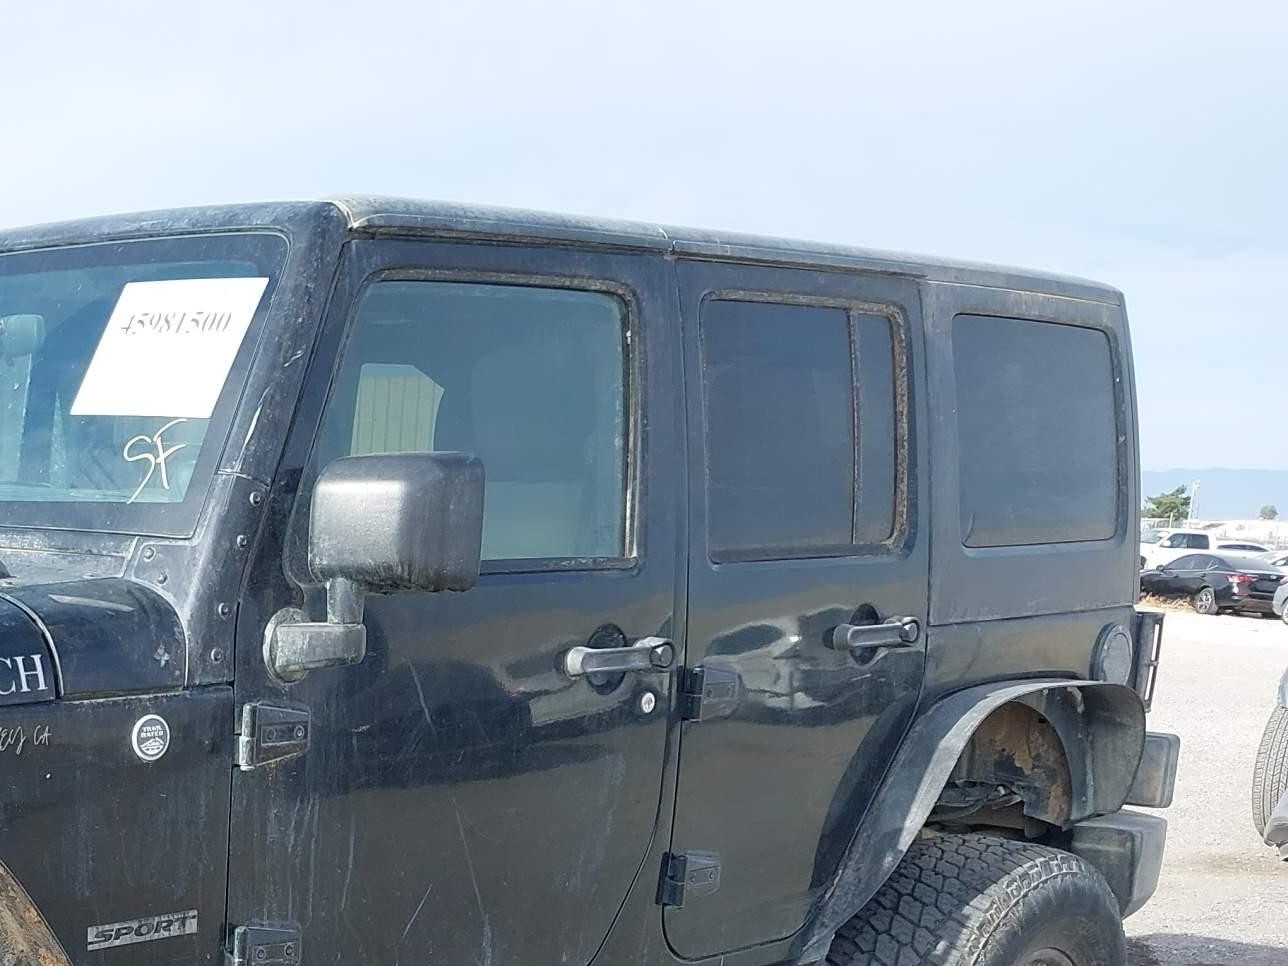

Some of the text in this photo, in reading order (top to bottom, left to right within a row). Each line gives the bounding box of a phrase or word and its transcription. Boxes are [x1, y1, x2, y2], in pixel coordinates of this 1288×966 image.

[121, 311, 232, 335] 45981500
[123, 418, 188, 505] SF
[33, 725, 52, 746] CA
[89, 915, 197, 945] SPORT
